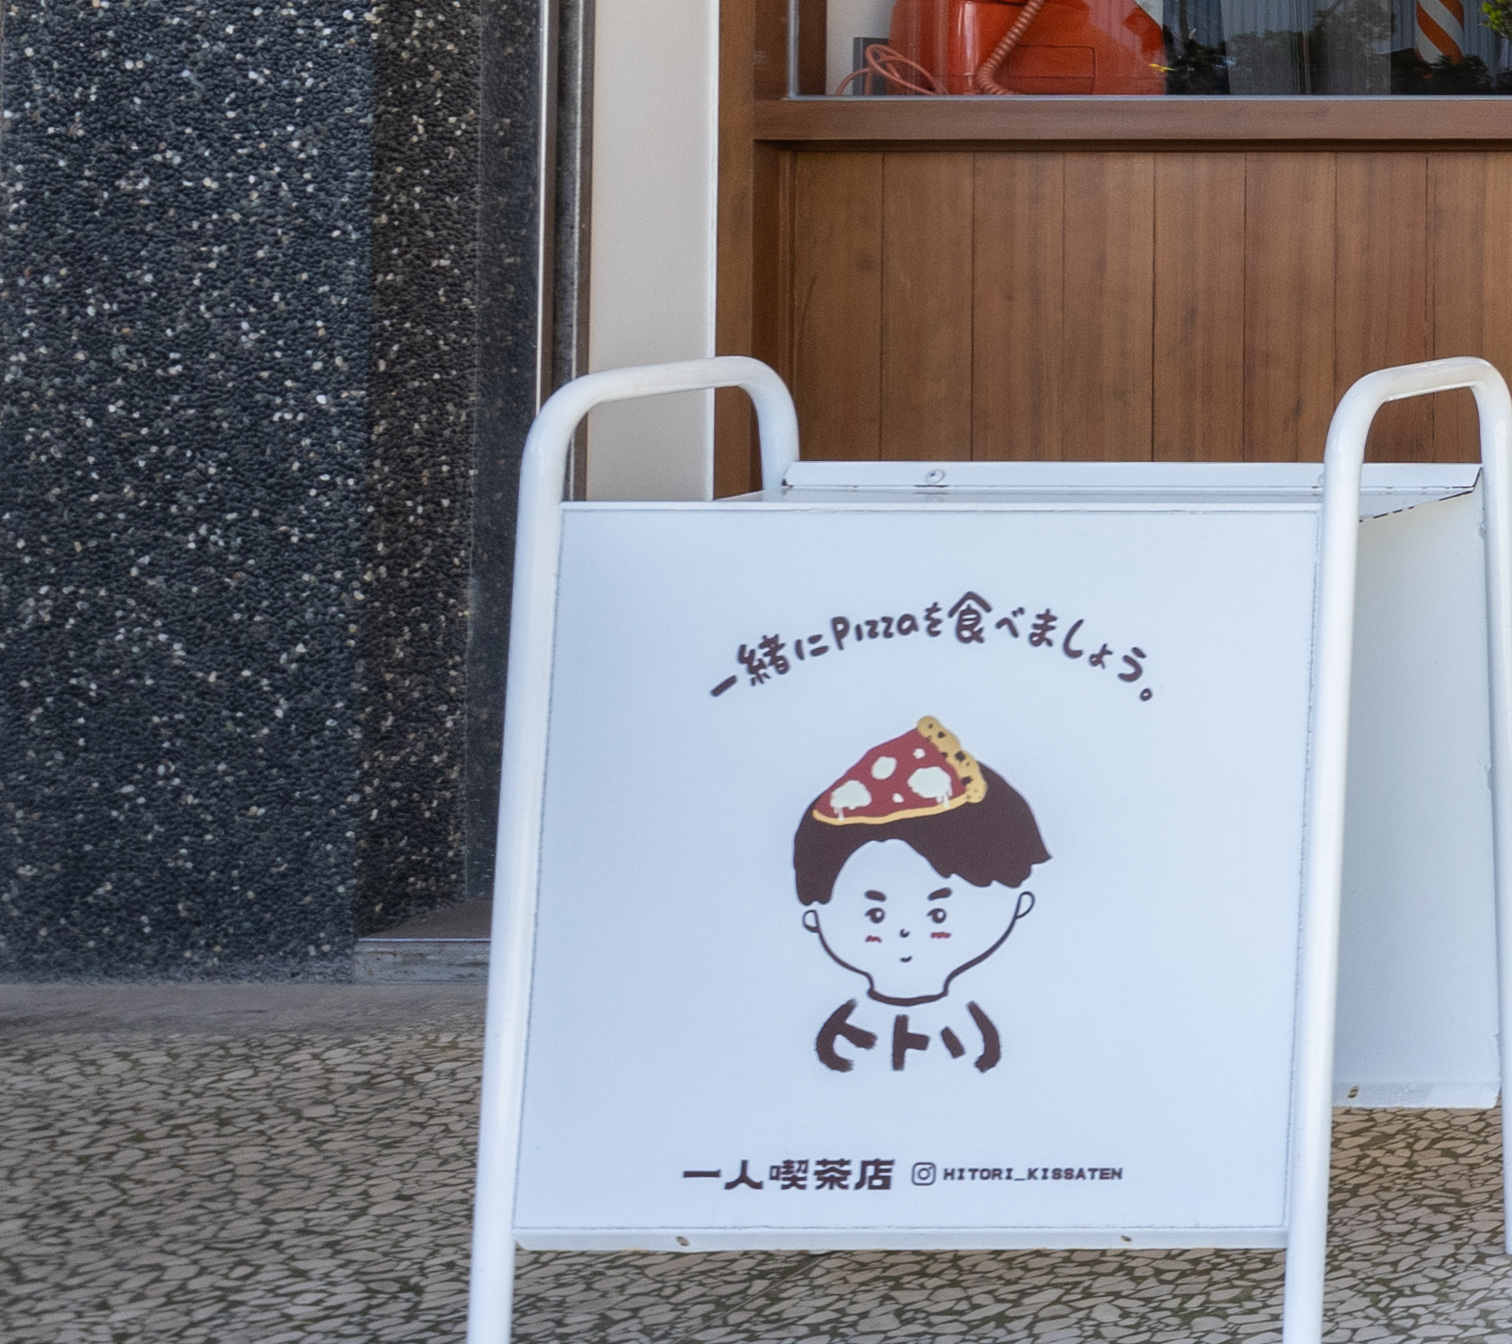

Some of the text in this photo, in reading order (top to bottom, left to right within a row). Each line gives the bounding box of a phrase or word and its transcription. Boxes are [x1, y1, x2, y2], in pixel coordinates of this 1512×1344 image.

[814, 998, 1002, 1073] ヒトリ
[682, 1158, 1123, 1191] 一人喫茶店 HITORI_KISSATEN
